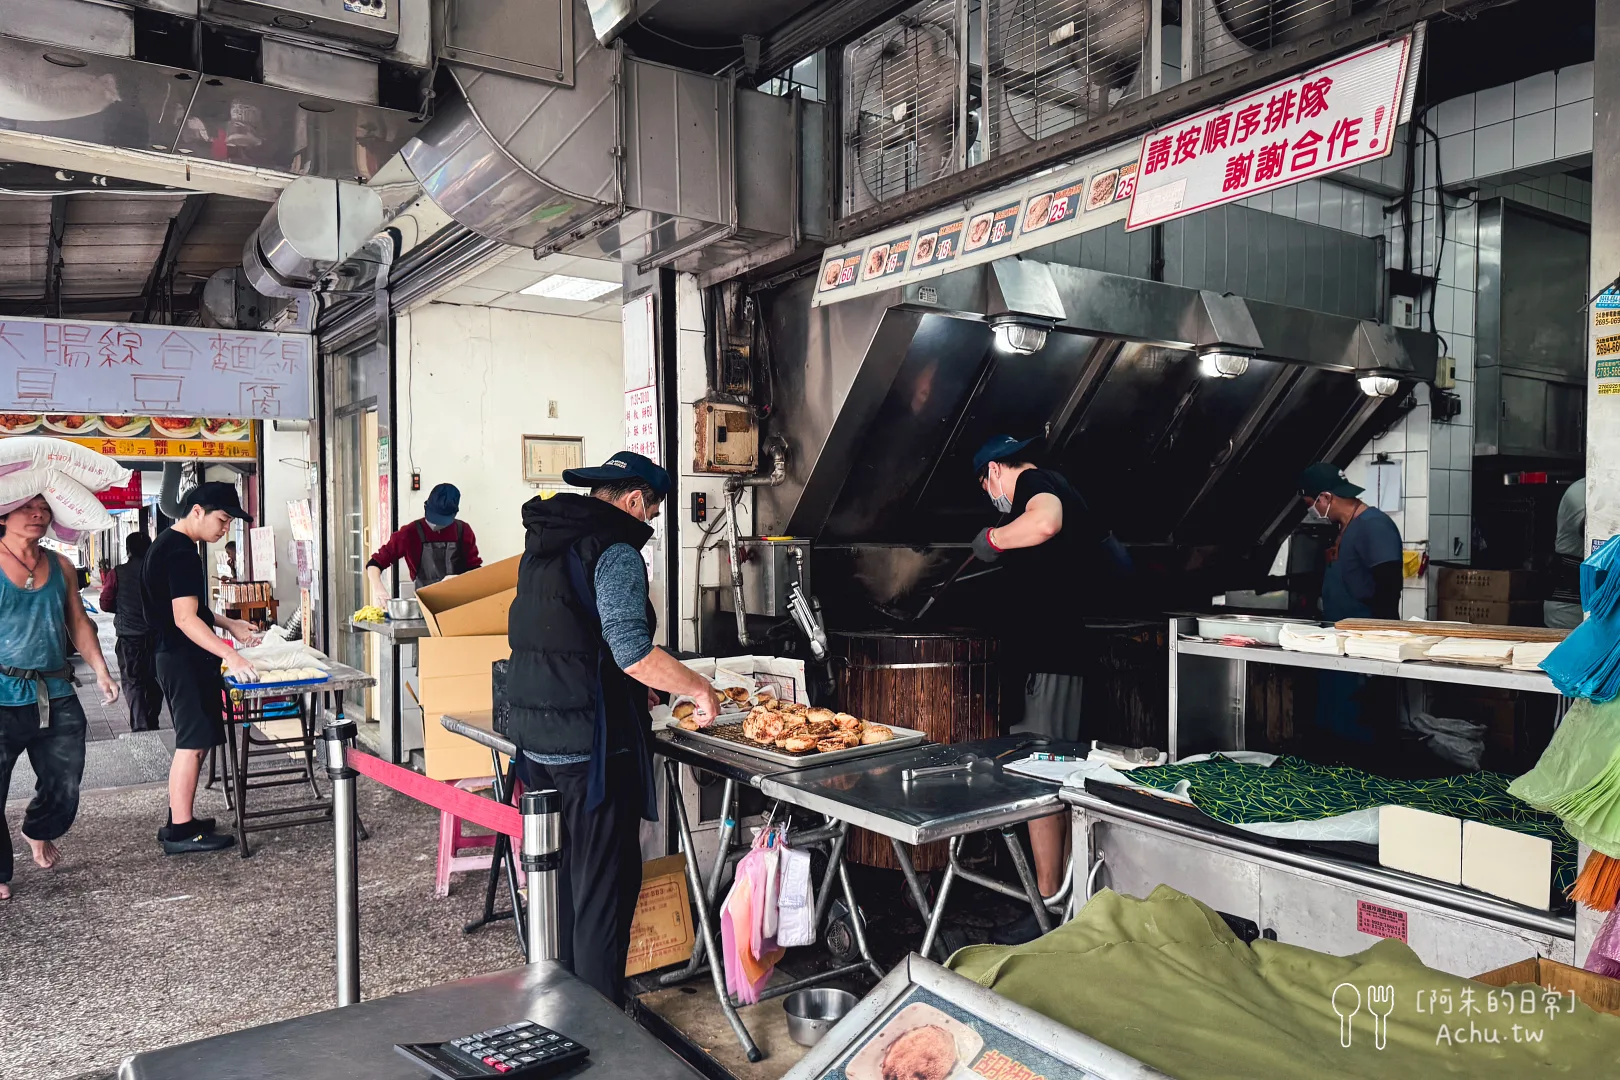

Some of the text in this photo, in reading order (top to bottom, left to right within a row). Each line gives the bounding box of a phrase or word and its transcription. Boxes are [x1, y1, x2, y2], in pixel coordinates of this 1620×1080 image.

[1145, 76, 1333, 175] 請按順序排隊
[1049, 201, 1066, 222] 25
[841, 267, 853, 283] 60
[972, 1048, 1048, 1080] 胡椒
